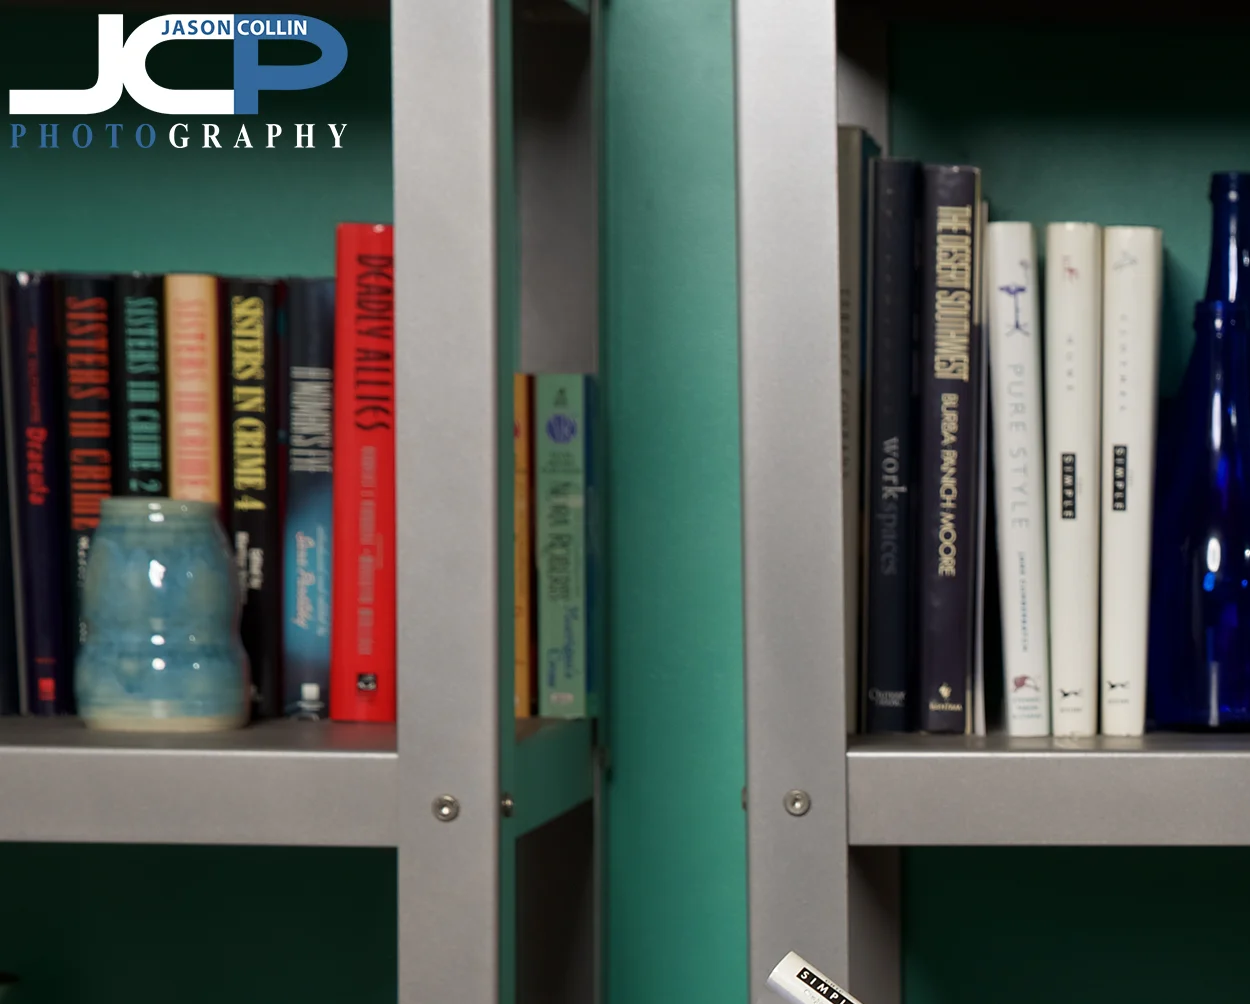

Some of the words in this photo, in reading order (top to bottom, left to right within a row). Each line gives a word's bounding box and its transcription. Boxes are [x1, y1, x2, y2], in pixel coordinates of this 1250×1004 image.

[936, 205, 972, 233] THE
[354, 254, 394, 340] DEADLY
[936, 234, 972, 289] DESERT
[66, 296, 108, 400] SISTERS
[126, 297, 158, 375] SISTERS
[175, 299, 210, 383] SISTERS
[232, 296, 265, 380] SISTERS
[934, 290, 971, 382] SOUTHWEST
[70, 411, 110, 439] IN
[128, 380, 159, 401] IN
[233, 385, 265, 413] IN
[352, 346, 392, 432] ALLIES
[1007, 361, 1027, 434] PURE
[25, 426, 50, 505] Dracula
[128, 409, 161, 472] CRIME
[233, 417, 265, 491] CRIME
[70, 448, 111, 530] CRIME
[129, 479, 162, 493] 2
[233, 495, 266, 511] 4
[1010, 447, 1031, 532] STYLE
[1063, 455, 1075, 519] SIMPLE
[1114, 446, 1126, 511] SIMPLE
[938, 511, 957, 577] MOORE
